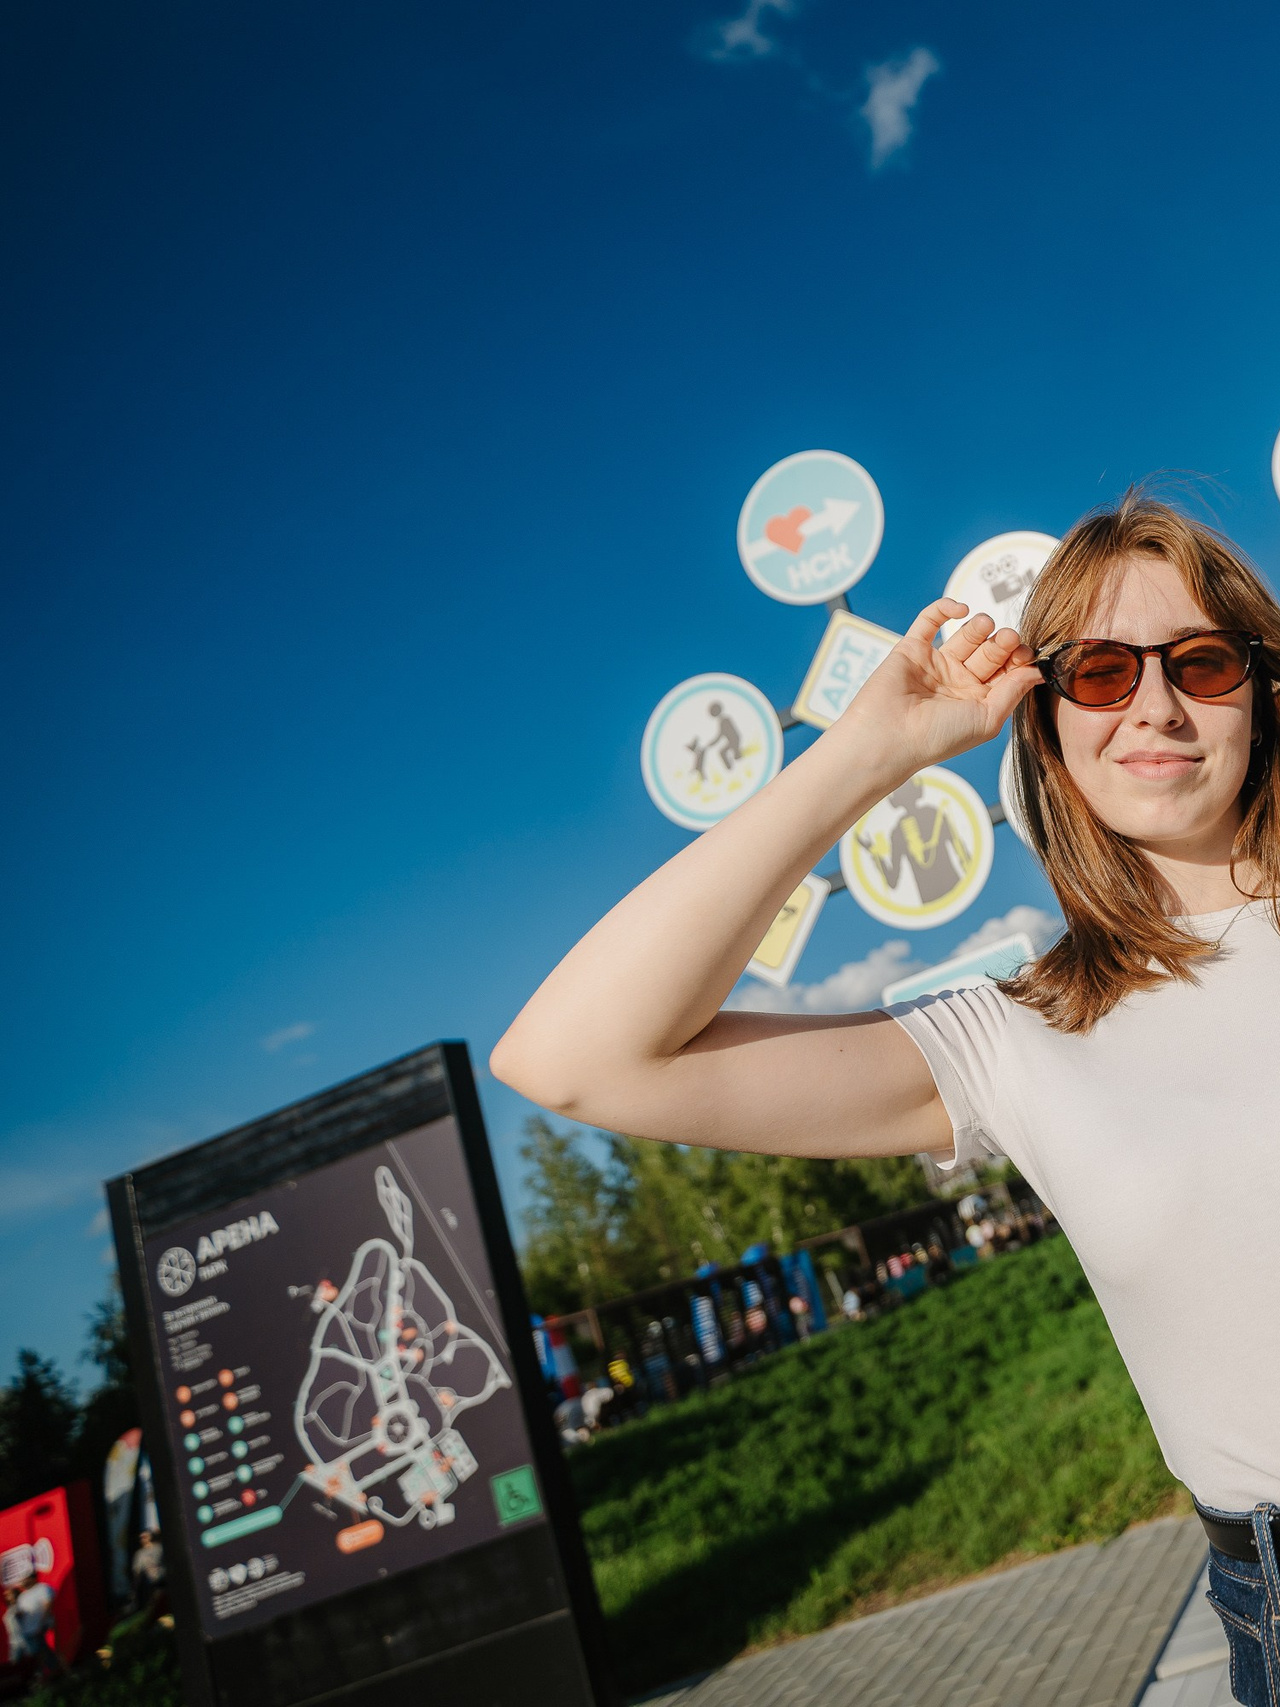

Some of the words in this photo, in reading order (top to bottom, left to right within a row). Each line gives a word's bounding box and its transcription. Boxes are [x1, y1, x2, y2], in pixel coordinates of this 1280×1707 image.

[786, 543, 854, 590] НСК
[822, 637, 864, 712] АРТ
[197, 1210, 280, 1264] АРЕНА
